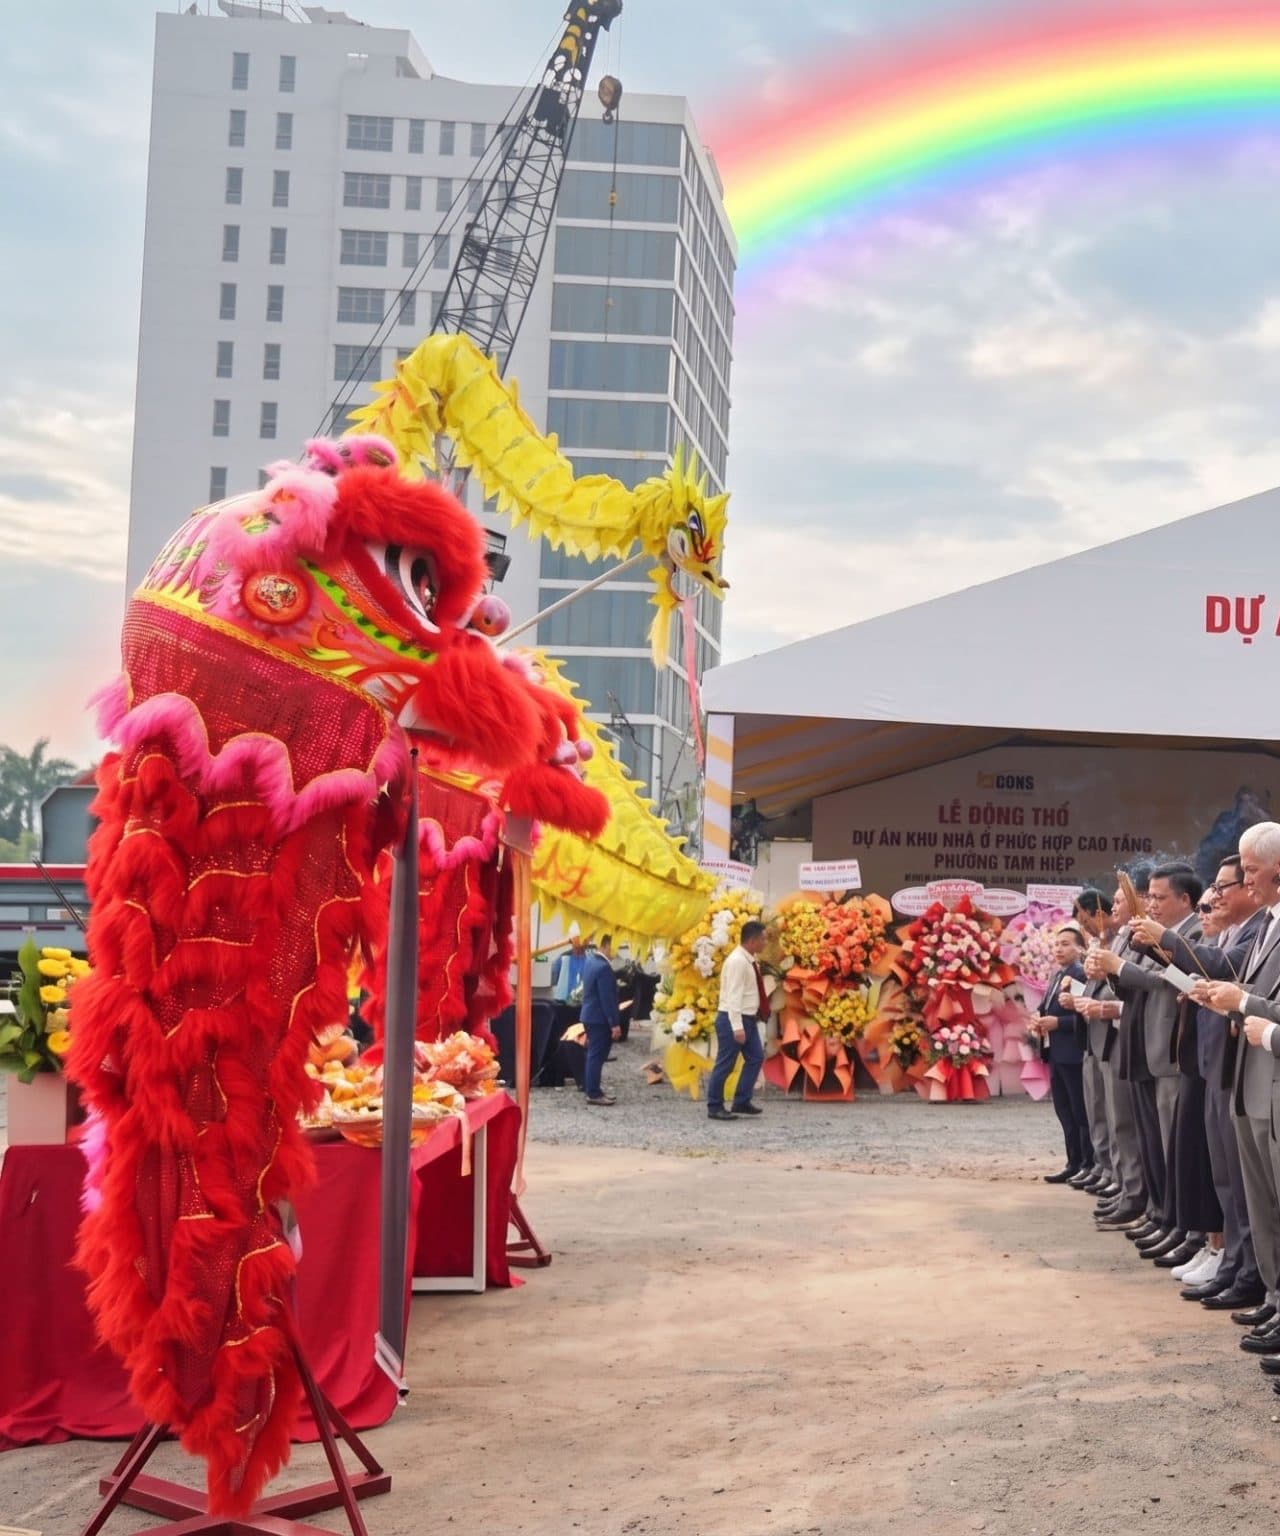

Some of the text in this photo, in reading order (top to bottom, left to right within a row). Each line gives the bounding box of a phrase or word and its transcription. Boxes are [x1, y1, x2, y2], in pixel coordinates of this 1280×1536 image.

[1205, 594, 1265, 645] DỰ
[968, 804, 1025, 829] ĐỘNG
[852, 829, 874, 849] DỰ
[879, 829, 901, 848] ÁN
[906, 831, 938, 848] KHU
[943, 830, 975, 849] NHÀ
[996, 831, 1037, 850] PHỨC
[1042, 834, 1073, 853] HỢP
[1077, 835, 1108, 851] CAO
[1002, 855, 1035, 870] TAM
[1040, 854, 1075, 874] HIỆP
